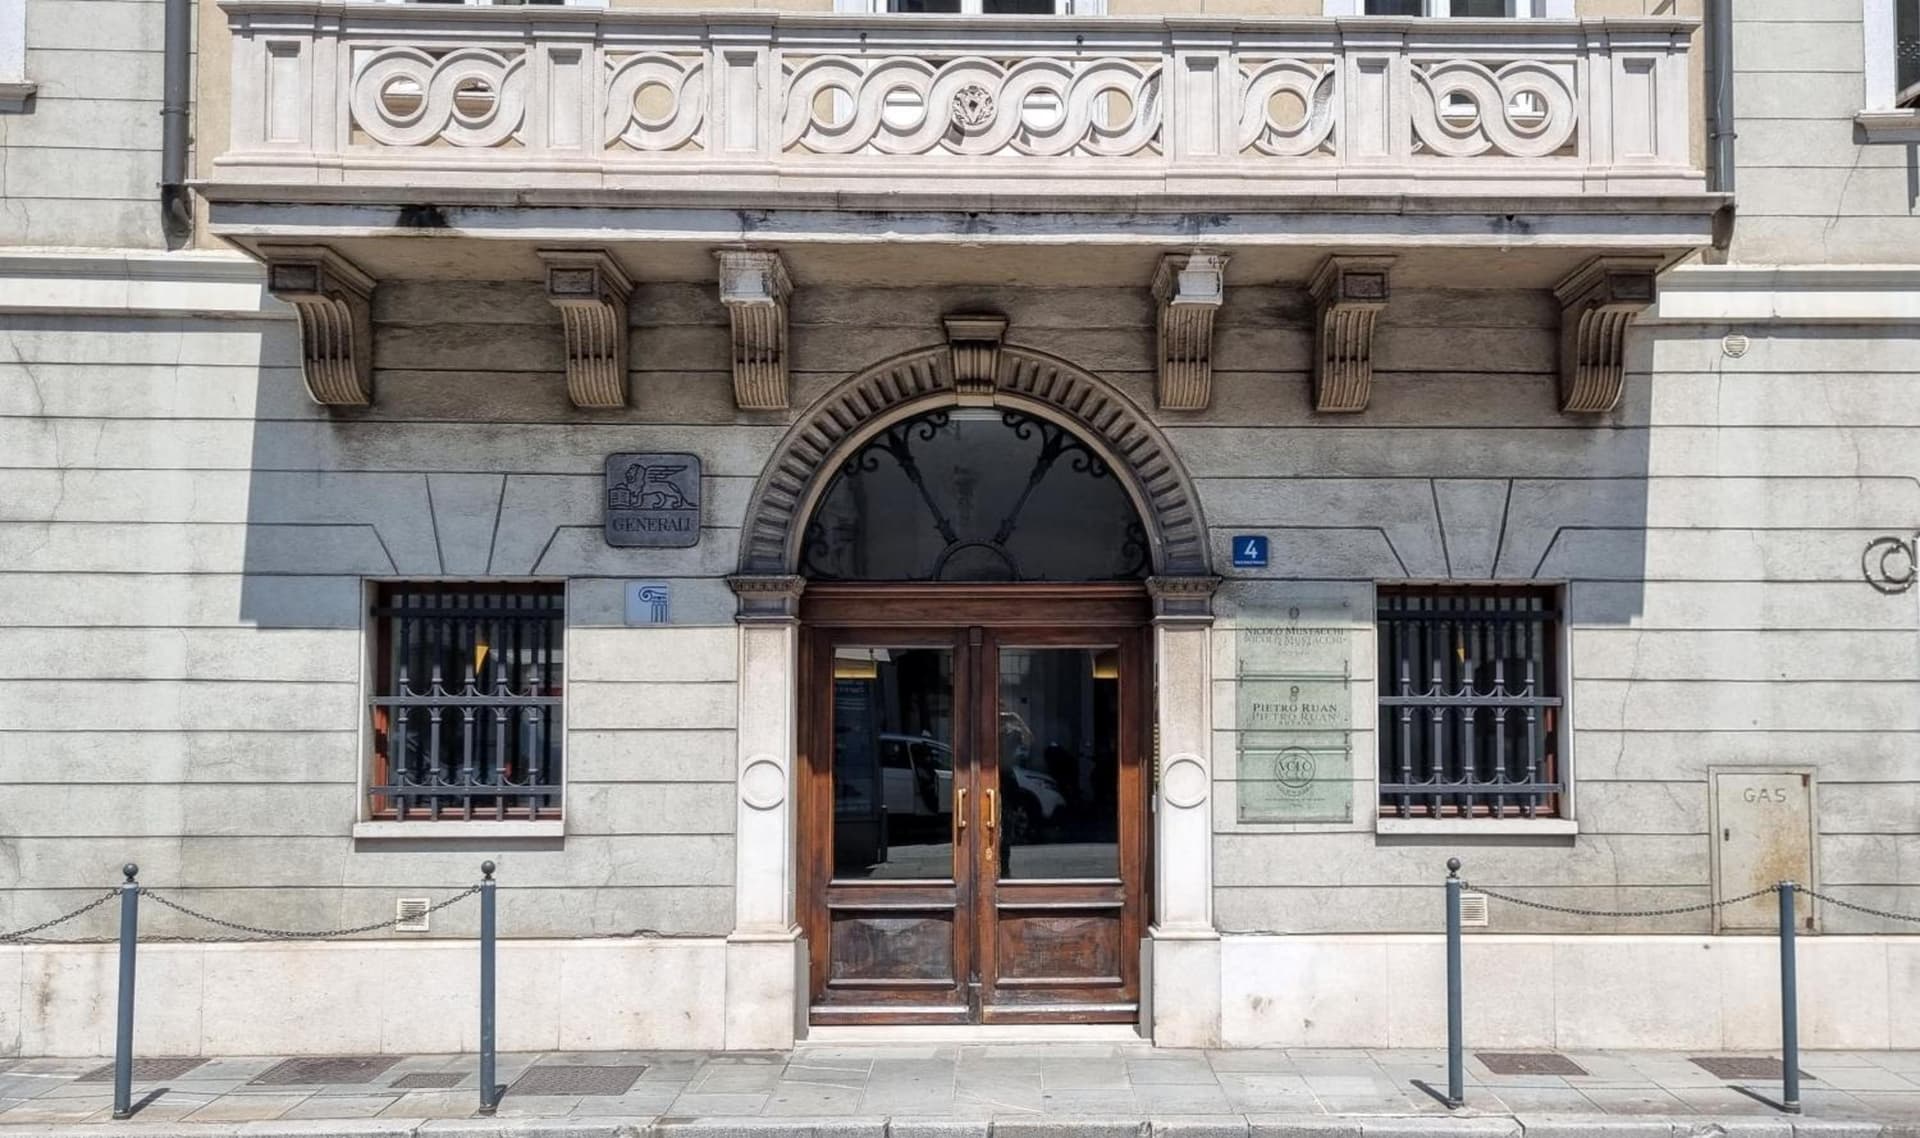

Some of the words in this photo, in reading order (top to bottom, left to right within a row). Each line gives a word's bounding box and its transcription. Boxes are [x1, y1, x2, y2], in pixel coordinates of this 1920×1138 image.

[612, 518, 691, 532] GENERALI
[1244, 539, 1258, 559] 4
[1253, 703, 1298, 713] PIETRO
[1302, 703, 1337, 713] RUAN
[1744, 788, 1786, 803] GAS
